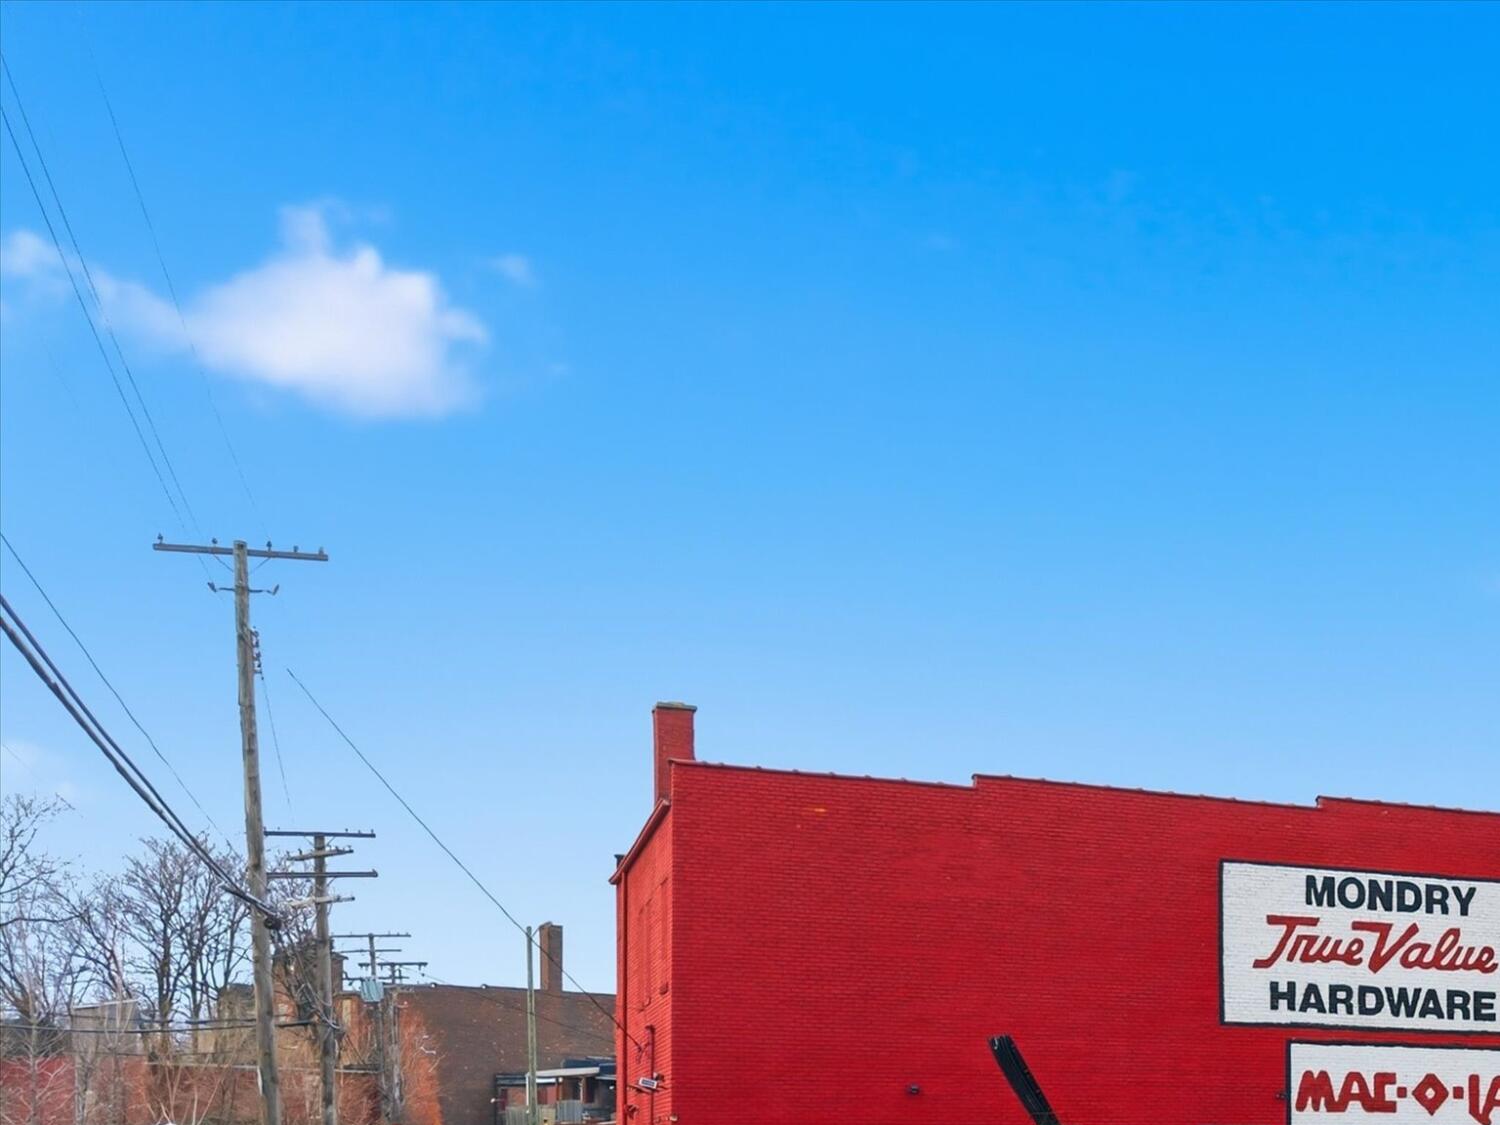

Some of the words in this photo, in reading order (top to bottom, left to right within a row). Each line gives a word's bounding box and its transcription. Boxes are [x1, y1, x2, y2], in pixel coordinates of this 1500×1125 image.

[1305, 875, 1477, 916] MONDRY
[1252, 914, 1364, 969] True
[1351, 920, 1499, 974] Value
[1269, 981, 1497, 1022] HARDWARE
